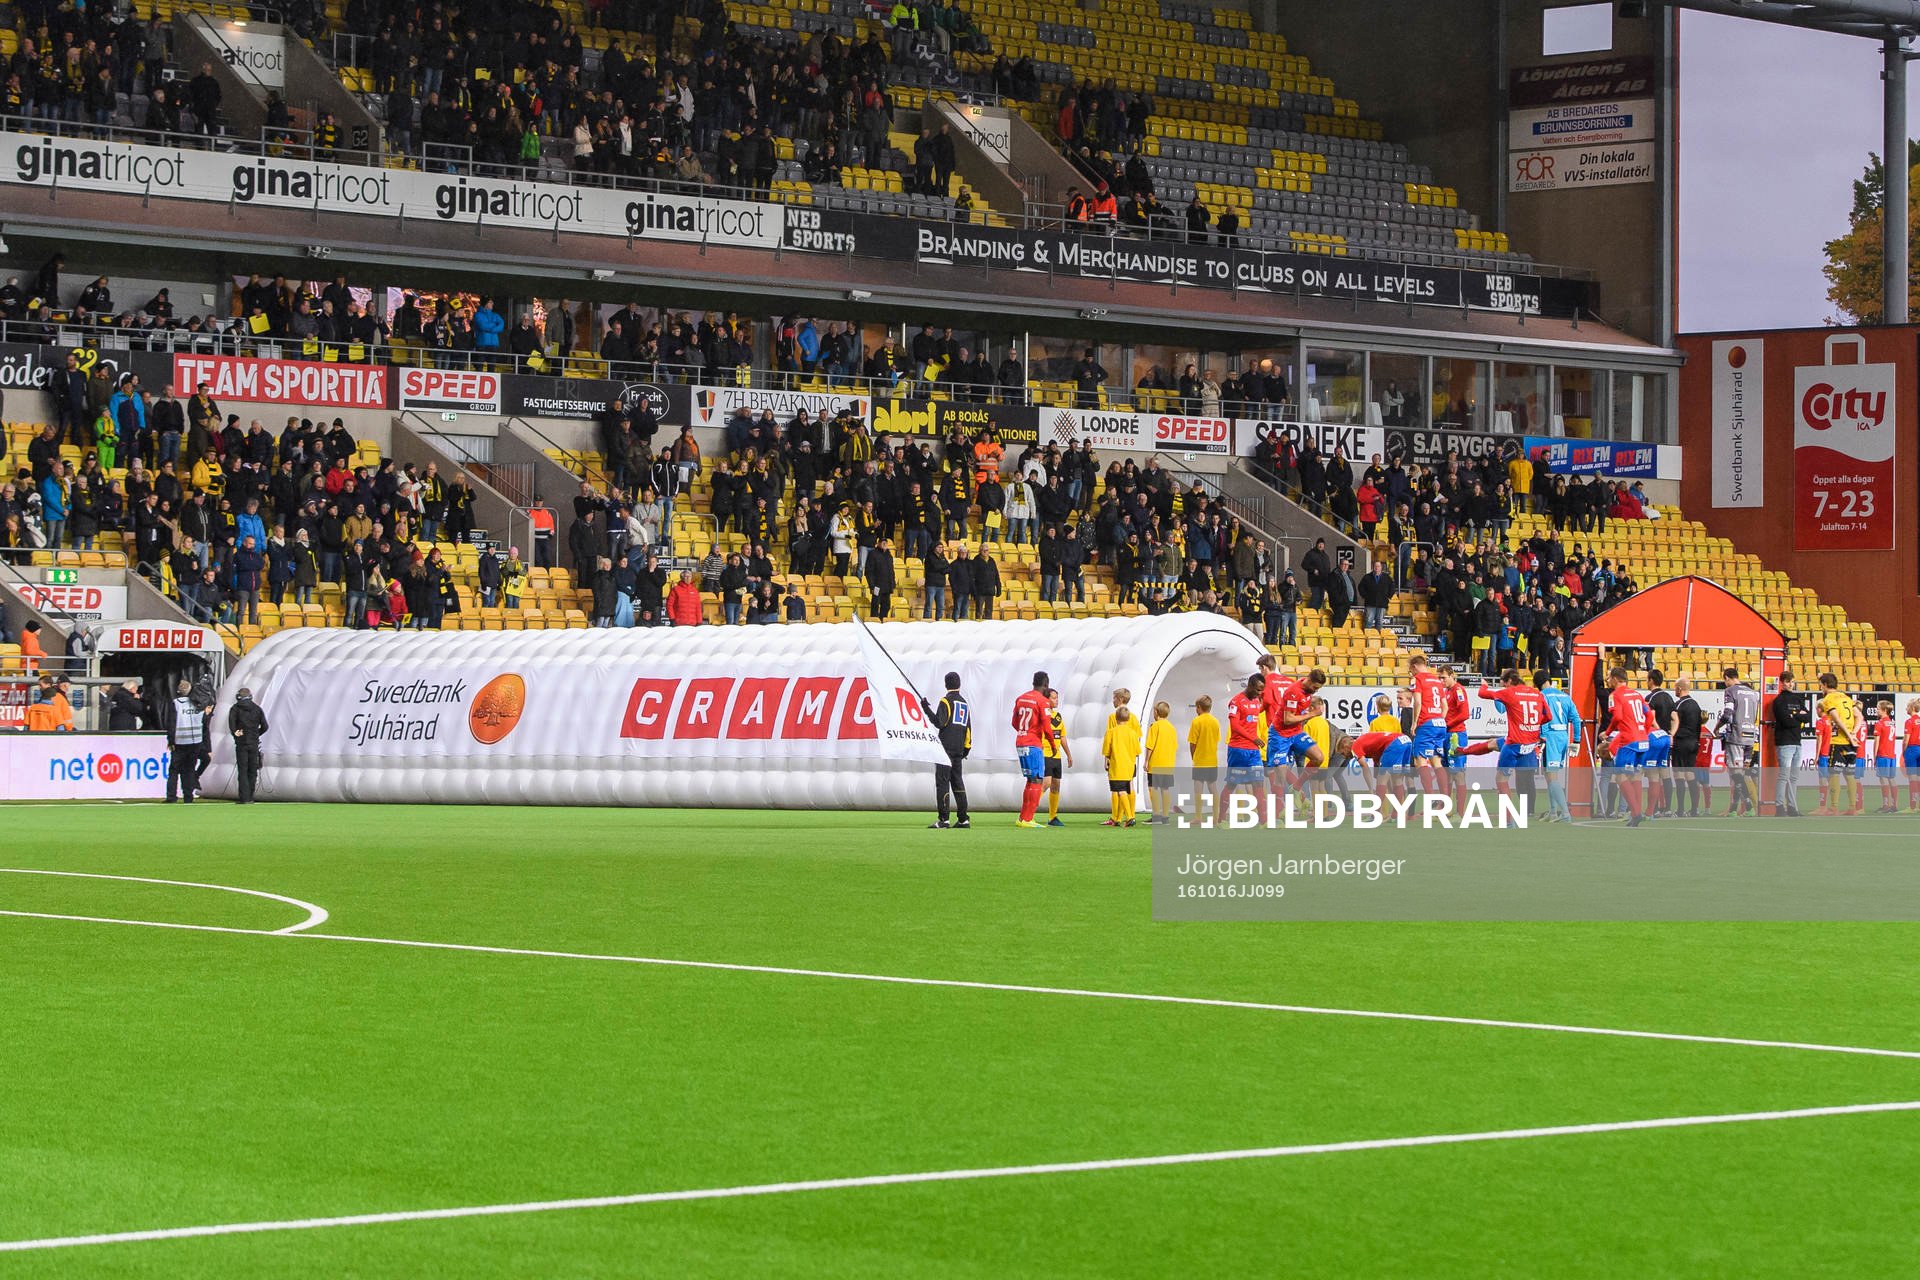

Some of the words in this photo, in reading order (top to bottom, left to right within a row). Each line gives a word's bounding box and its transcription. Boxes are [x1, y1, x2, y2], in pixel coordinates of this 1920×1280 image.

[1520, 63, 1626, 82] Lövdalens
[1614, 80, 1646, 92] AB
[1547, 109, 1559, 119] AB
[1563, 104, 1618, 118] BREDAREDS
[1540, 117, 1625, 133] BRUNNSBORRNING
[17, 137, 185, 188] ginatricot
[1579, 154, 1598, 165] Din
[1601, 150, 1635, 163] lokala
[233, 158, 390, 205] ginatricot
[1564, 165, 1650, 182] VVS-installatör!
[1515, 182, 1556, 190] BREDAREDS
[436, 178, 583, 223] ginatricot
[626, 194, 763, 239] ginatricot
[787, 208, 821, 229] NEB
[793, 230, 855, 252] SPORTS
[1034, 240, 1049, 263] &
[1486, 274, 1512, 292] NEB
[1490, 291, 1539, 310] SPORTS
[178, 358, 258, 397] TEAM
[264, 363, 383, 405] SPORTIA
[405, 370, 497, 400] SPEED
[469, 403, 496, 411] GROUP
[523, 398, 606, 412] FASTIGHETSSERVICE
[724, 391, 745, 409] 7H
[751, 392, 841, 414] BEVAKNING
[1731, 371, 1745, 430] Sjuhärad
[1802, 383, 1887, 431] City
[943, 410, 956, 421] AB
[959, 409, 989, 423] BORÅS
[1082, 414, 1140, 435] LONDRÉ
[1156, 416, 1227, 442] SPEED
[1857, 422, 1870, 432] ICA
[1413, 432, 1442, 455] S.A
[1447, 435, 1495, 457] BYGG
[1731, 432, 1743, 502] Swedbank
[1813, 475, 1836, 485] Öppet
[1838, 475, 1851, 484] alla
[1852, 475, 1875, 486] dagar
[1813, 490, 1875, 518] 7-23
[1820, 523, 1849, 531] Julafton
[1851, 522, 1867, 531] 7-14
[18, 586, 103, 610] SPEED
[122, 632, 201, 646] CRAMO
[359, 678, 467, 704] Swedbank
[634, 689, 875, 725] CRAMO
[1520, 701, 1538, 724] 15
[1629, 700, 1646, 723] 10
[1744, 698, 1750, 718] 1
[1843, 701, 1851, 719] 5
[349, 713, 438, 746] Sjuhärad
[1019, 707, 1032, 731] 27
[887, 730, 927, 741] SVENSKA
[1703, 738, 1710, 753] 3
